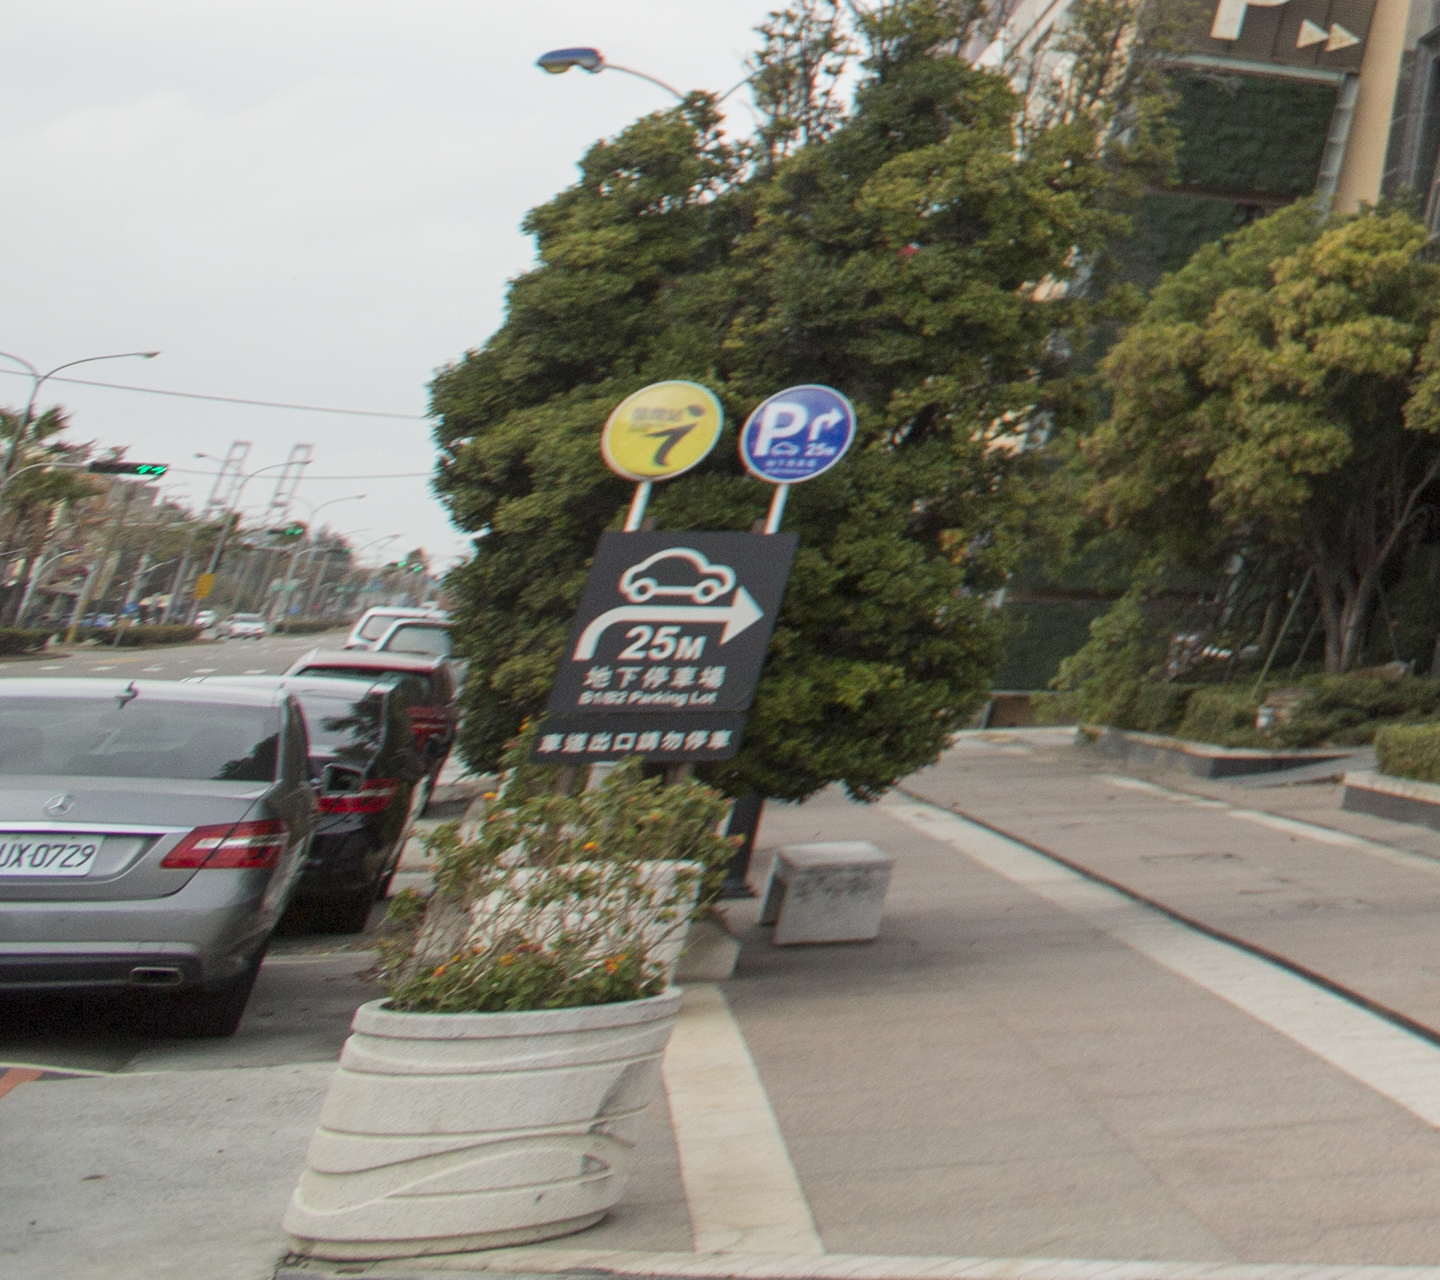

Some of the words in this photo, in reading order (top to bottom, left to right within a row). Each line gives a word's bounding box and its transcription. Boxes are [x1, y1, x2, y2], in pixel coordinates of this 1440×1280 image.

[753, 402, 808, 457] P
[617, 625, 707, 661] 25M
[582, 665, 727, 689] 地下停車場
[626, 691, 689, 708] Parking
[687, 691, 718, 706] Lot
